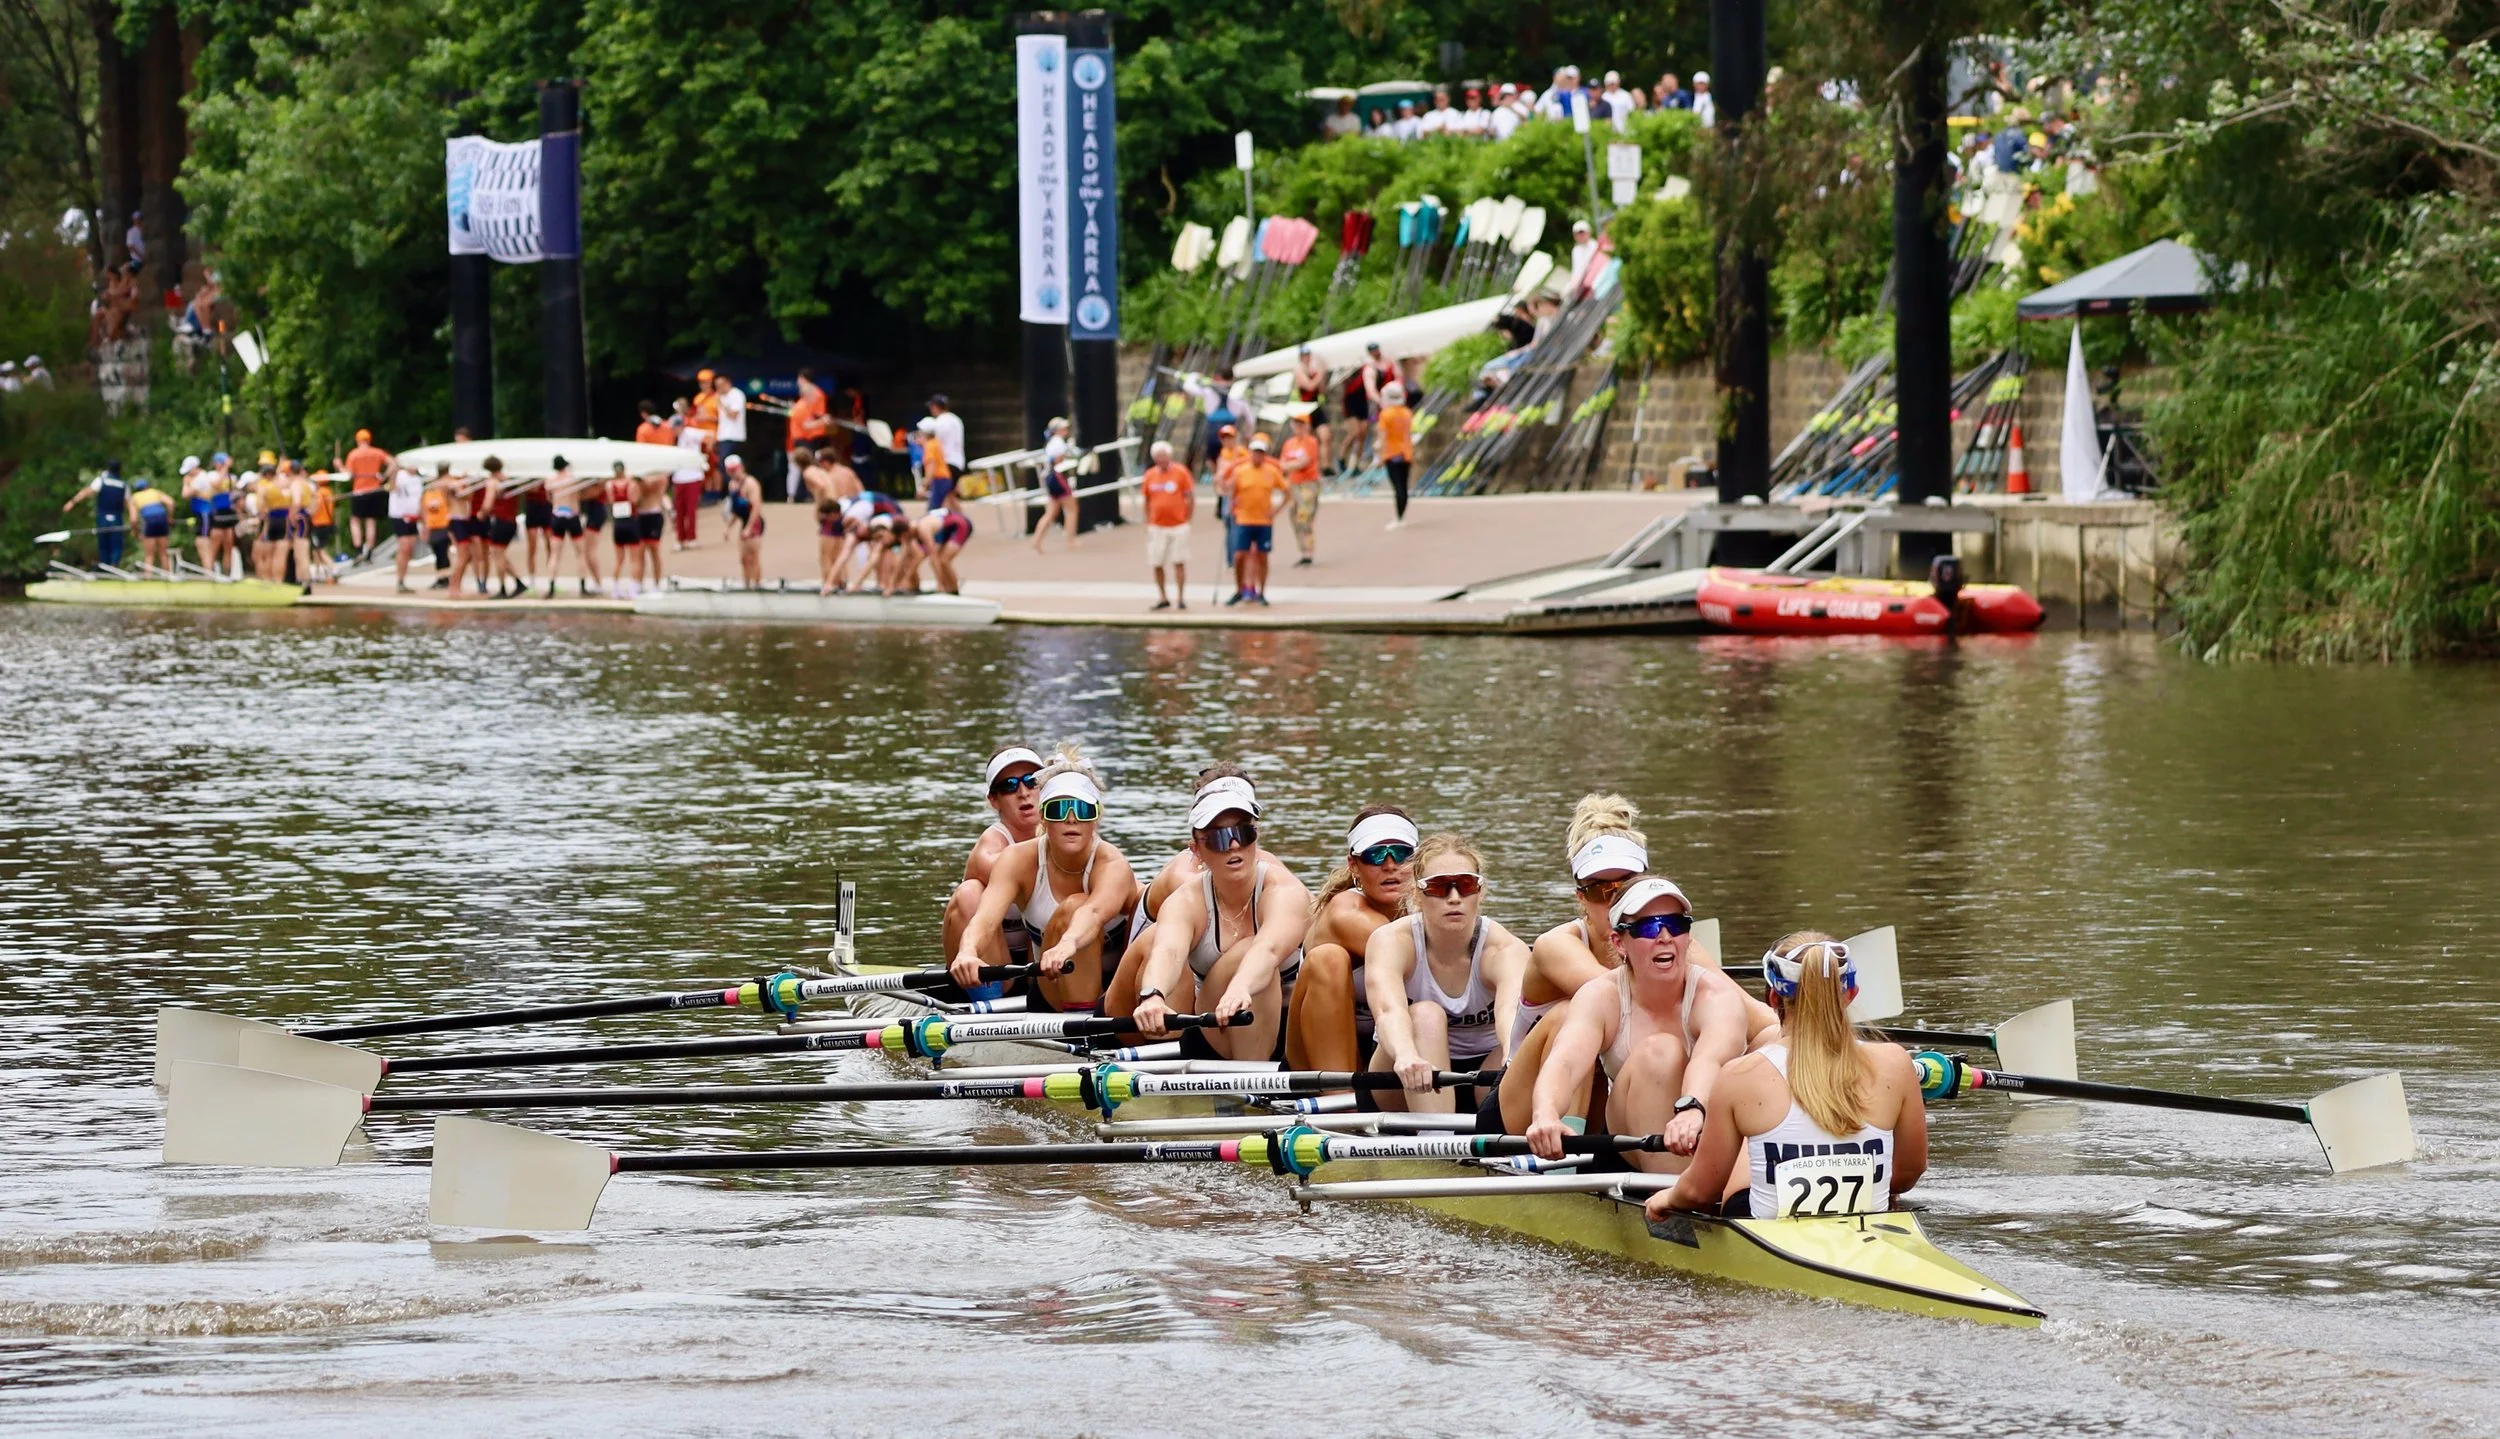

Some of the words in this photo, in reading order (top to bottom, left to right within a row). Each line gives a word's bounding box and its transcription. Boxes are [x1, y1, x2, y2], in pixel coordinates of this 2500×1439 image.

[1042, 83, 1055, 157] HEAD
[1082, 92, 1099, 171] HEAD
[1081, 172, 1099, 186] of
[1078, 186, 1103, 199] the
[1043, 190, 1055, 277] YARRA
[1083, 200, 1101, 292] YARRA
[1777, 598, 1811, 617] LIFE
[1827, 600, 1882, 620] GUARD
[816, 981, 865, 995] Australian
[966, 1024, 1019, 1037] Australian
[822, 1038, 861, 1049] MELBOURNE
[1160, 1079, 1232, 1092] Australian
[1233, 1076, 1287, 1090] BOATRACE
[964, 1087, 1015, 1098] MELBOURNE
[1165, 1150, 1213, 1161] MELBOURNE
[1349, 1145, 1416, 1158] Australian
[1417, 1141, 1469, 1156] BOATRACE
[1793, 1161, 1814, 1170] HEAD
[1815, 1159, 1826, 1168] OF
[1828, 1158, 1842, 1168] THE
[1843, 1157, 1868, 1167] YARRA
[1788, 1175, 1865, 1217] 227
